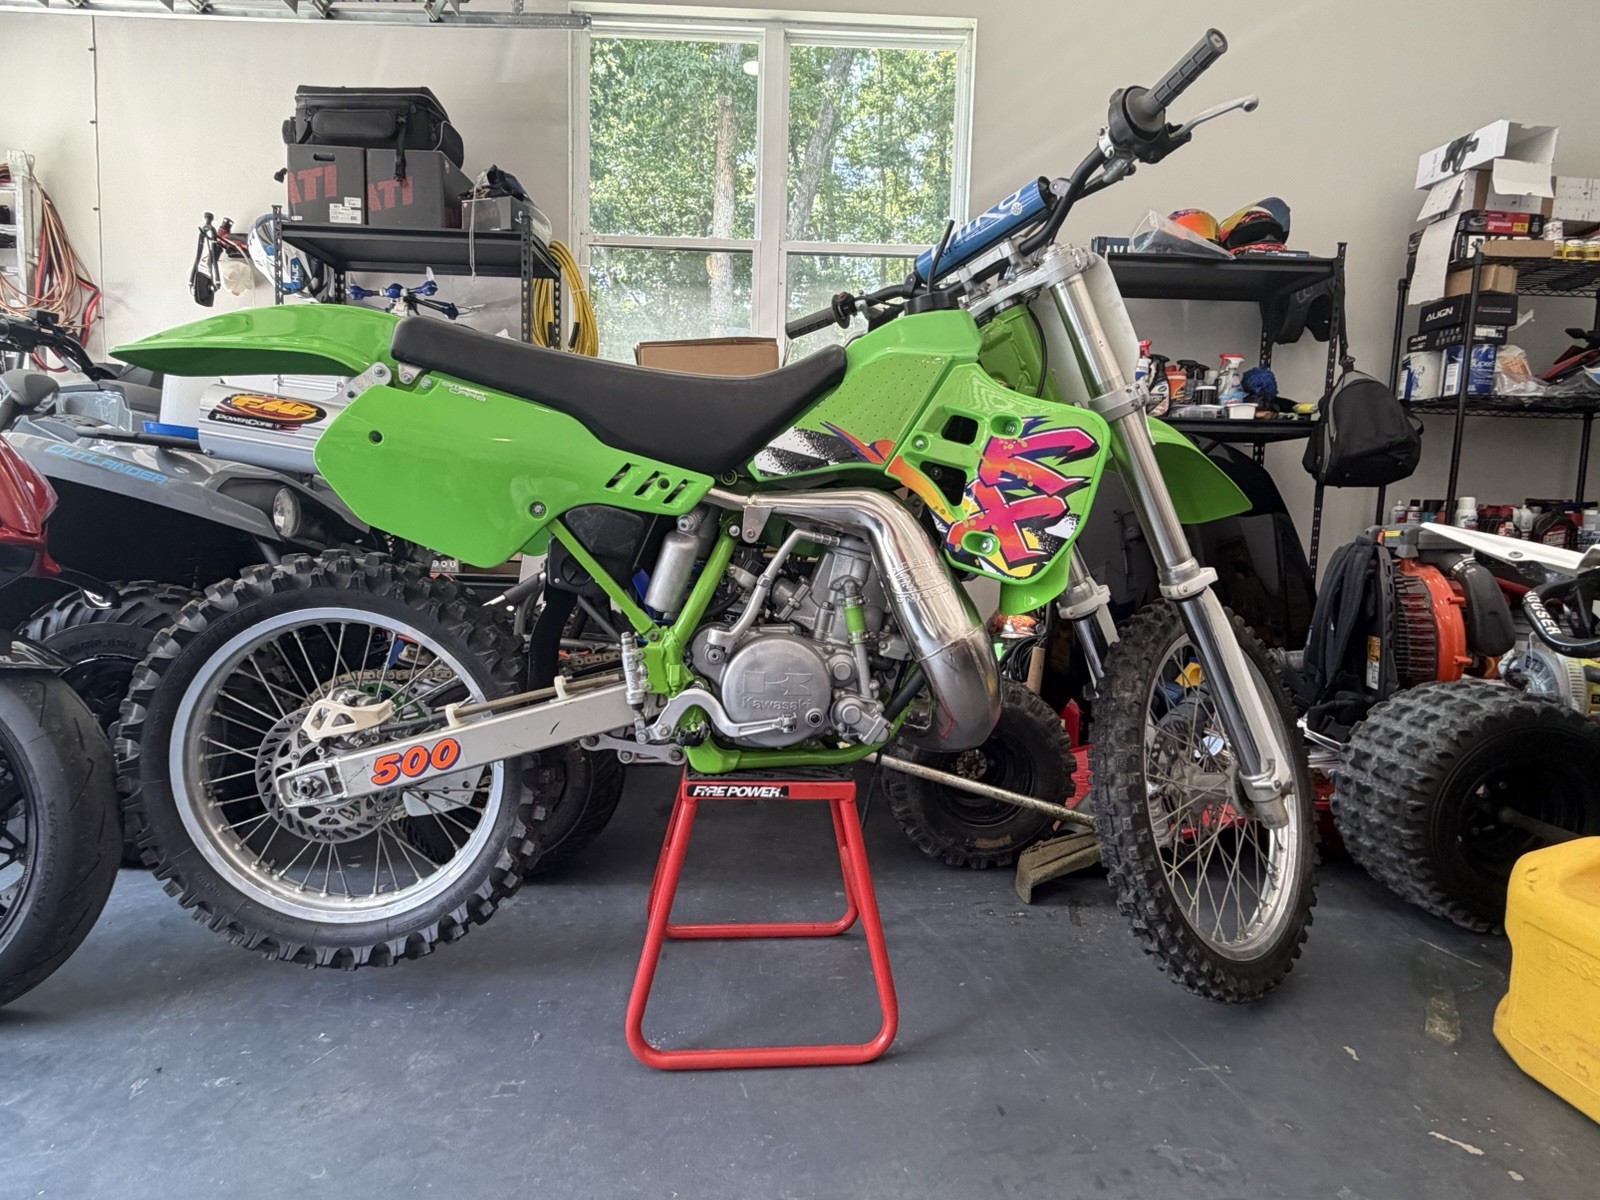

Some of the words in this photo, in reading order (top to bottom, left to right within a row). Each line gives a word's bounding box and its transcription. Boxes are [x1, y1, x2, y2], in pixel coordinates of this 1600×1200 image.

[291, 264, 300, 282] HJC
[1425, 306, 1454, 322] ALIGN
[230, 395, 318, 416] FMF
[44, 444, 169, 484] OUTLANDER
[742, 696, 812, 710] Kawasaki
[371, 738, 461, 785] 500
